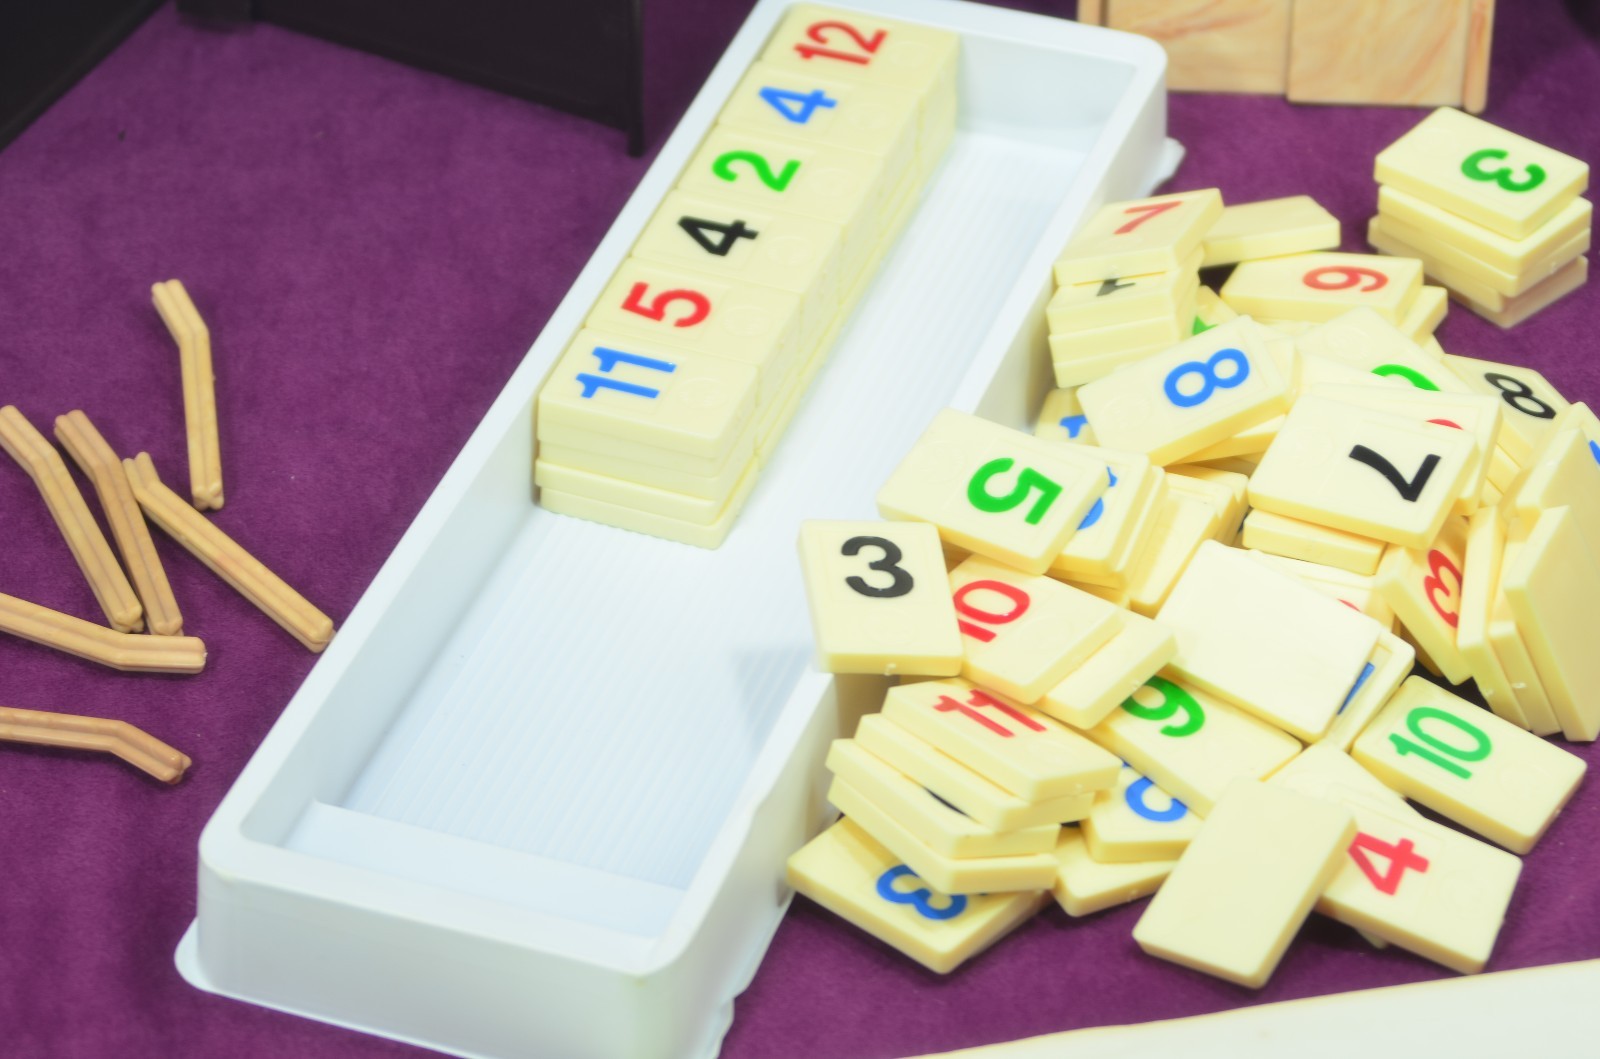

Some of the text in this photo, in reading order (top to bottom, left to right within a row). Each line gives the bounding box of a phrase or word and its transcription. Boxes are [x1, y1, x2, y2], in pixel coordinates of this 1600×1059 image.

[793, 20, 888, 66] 12
[759, 87, 837, 124] 4
[711, 150, 801, 193] 2
[1460, 148, 1547, 193] 3
[677, 216, 759, 257] 4
[1114, 200, 1184, 234] 7
[621, 282, 712, 328] 5
[575, 346, 677, 399] 11
[1163, 348, 1250, 408] 8
[1484, 372, 1556, 419] 8
[967, 457, 1063, 526] 5
[1348, 444, 1441, 502] 7
[840, 535, 914, 598] 3
[1424, 549, 1463, 629] 3
[932, 688, 1048, 738] 11
[1388, 706, 1492, 780] 10
[1347, 831, 1430, 895] 4
[876, 864, 967, 920] 3
